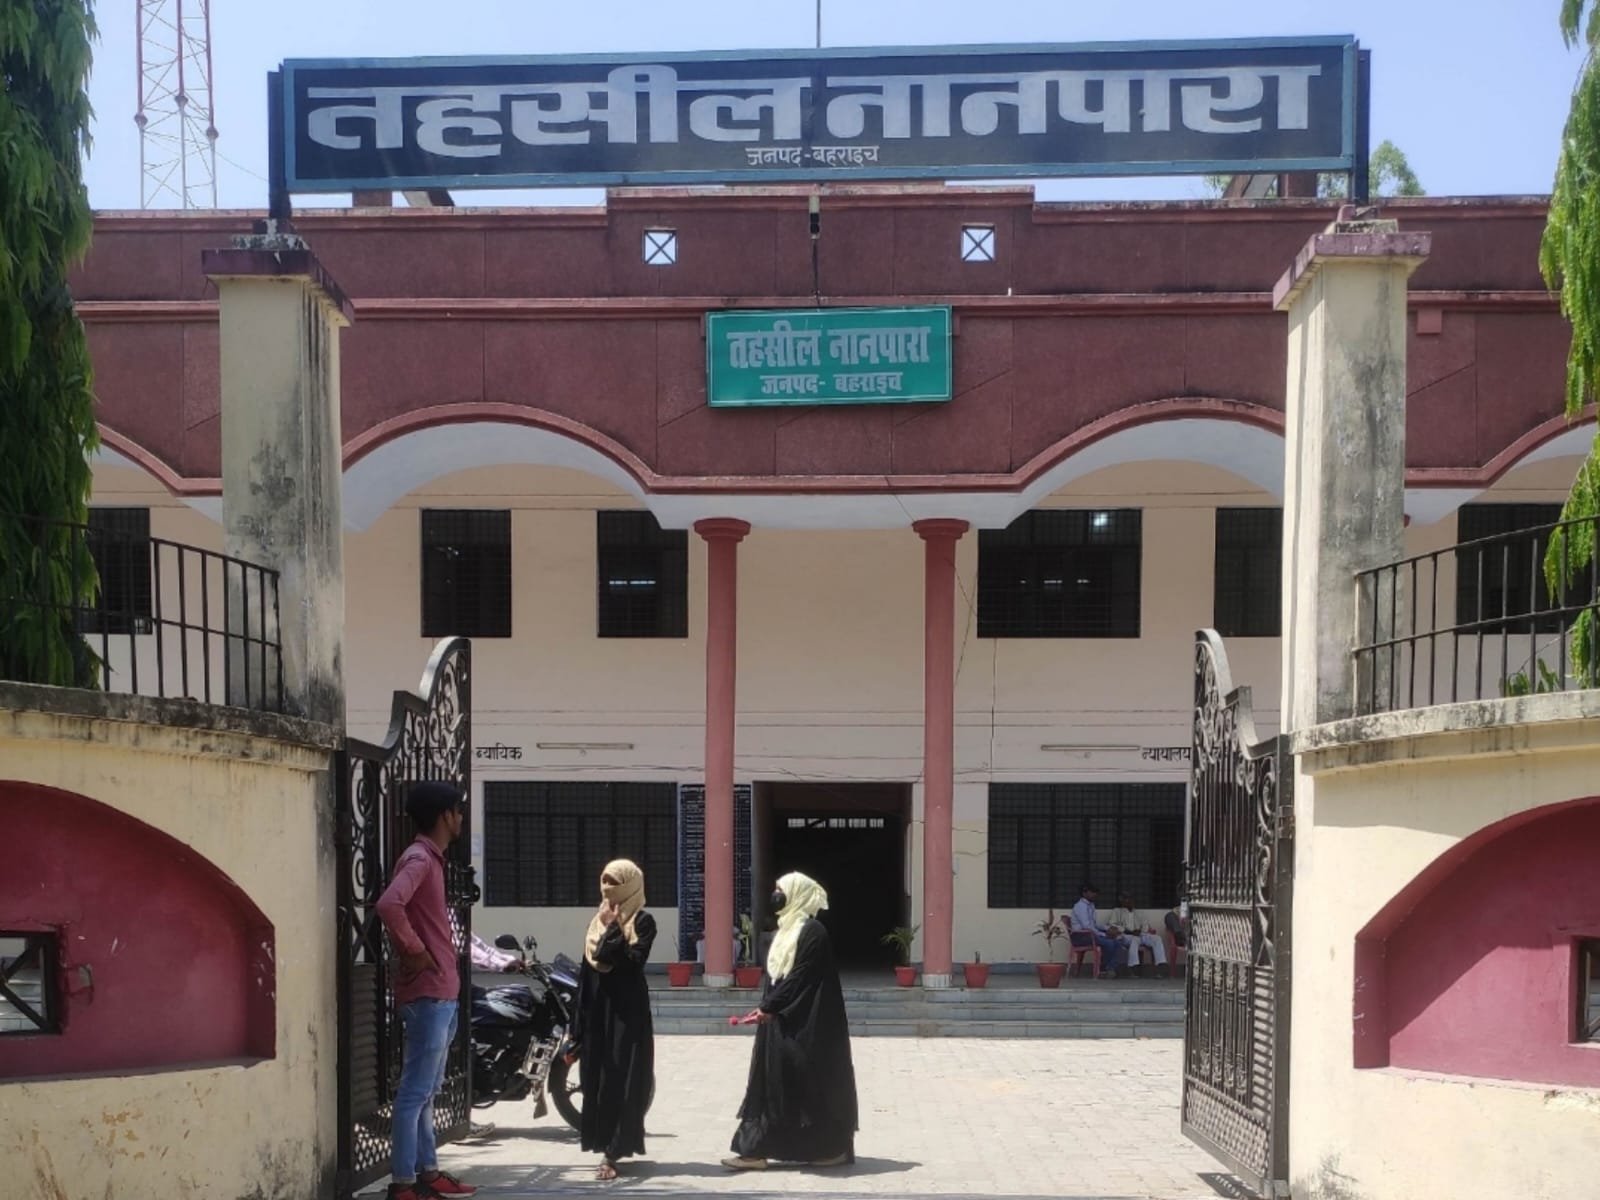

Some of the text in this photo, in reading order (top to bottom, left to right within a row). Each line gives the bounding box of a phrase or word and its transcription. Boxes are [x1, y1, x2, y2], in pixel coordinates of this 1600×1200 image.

[306, 64, 1323, 157] तहसील नानपारा
[727, 319, 931, 369] तहसील नानपारा
[1142, 747, 1192, 762] न्यायालय
